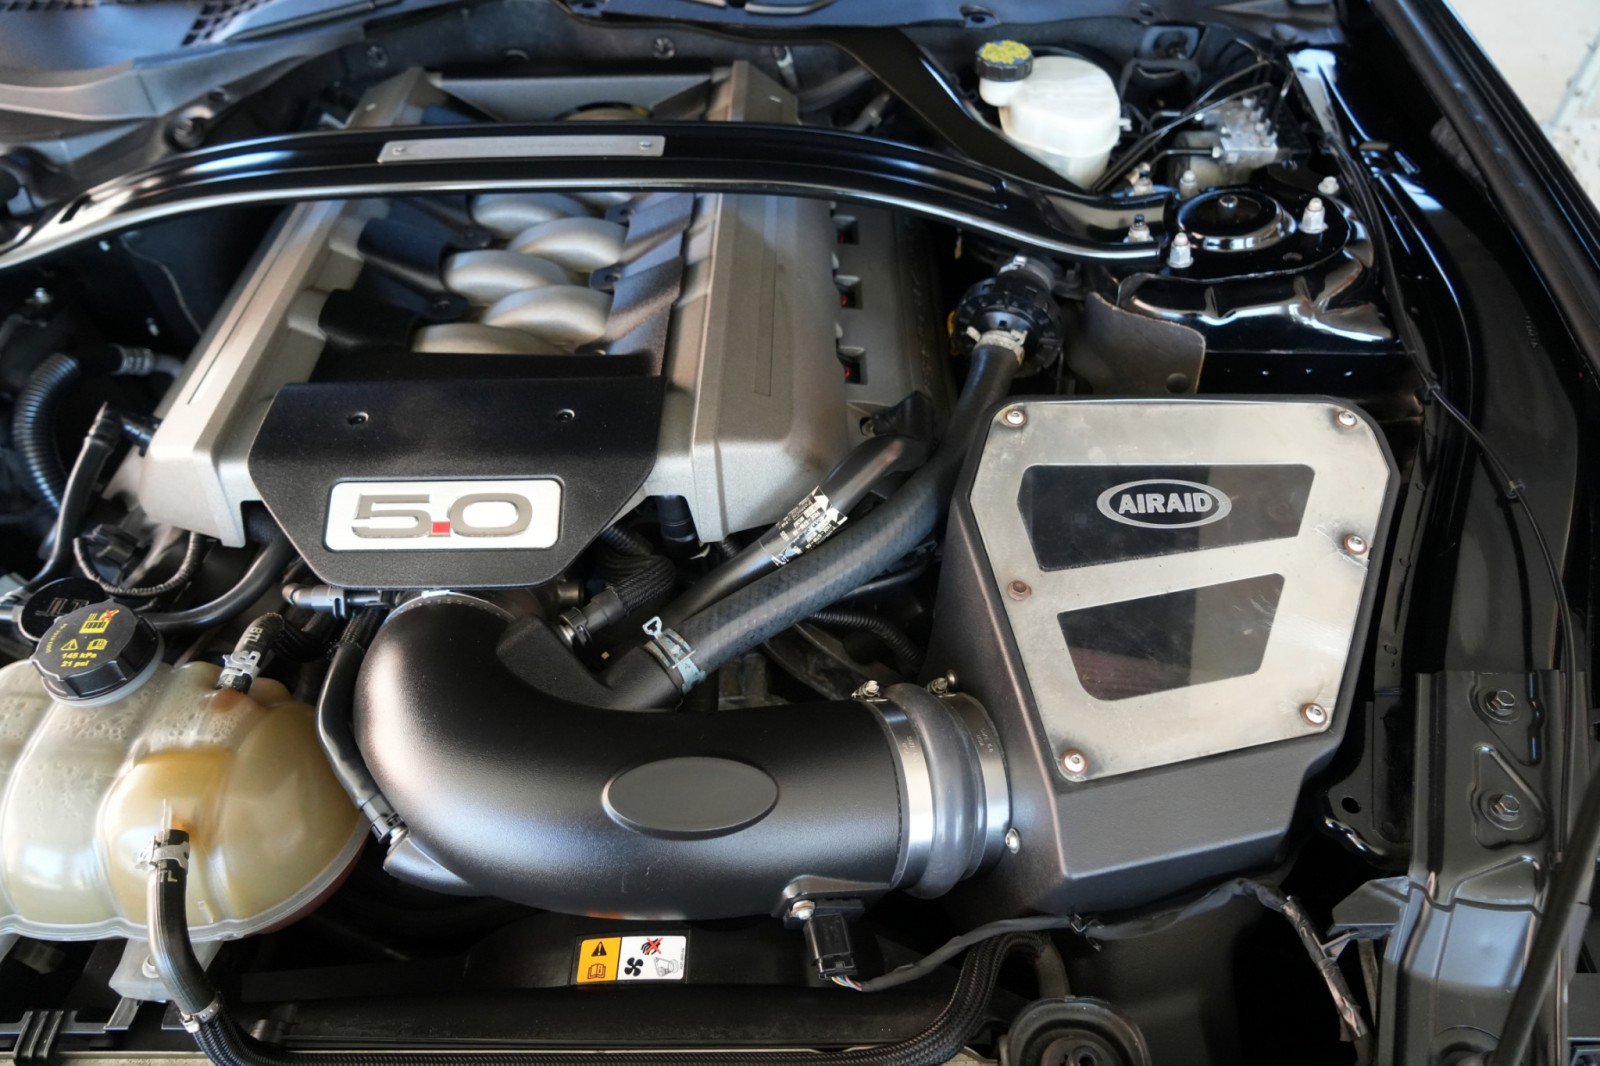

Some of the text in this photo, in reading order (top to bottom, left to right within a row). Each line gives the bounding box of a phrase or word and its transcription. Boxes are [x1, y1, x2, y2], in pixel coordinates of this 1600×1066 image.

[1118, 492, 1213, 514] AIRAID
[351, 492, 533, 539] 5.0
[73, 660, 90, 668] psi
